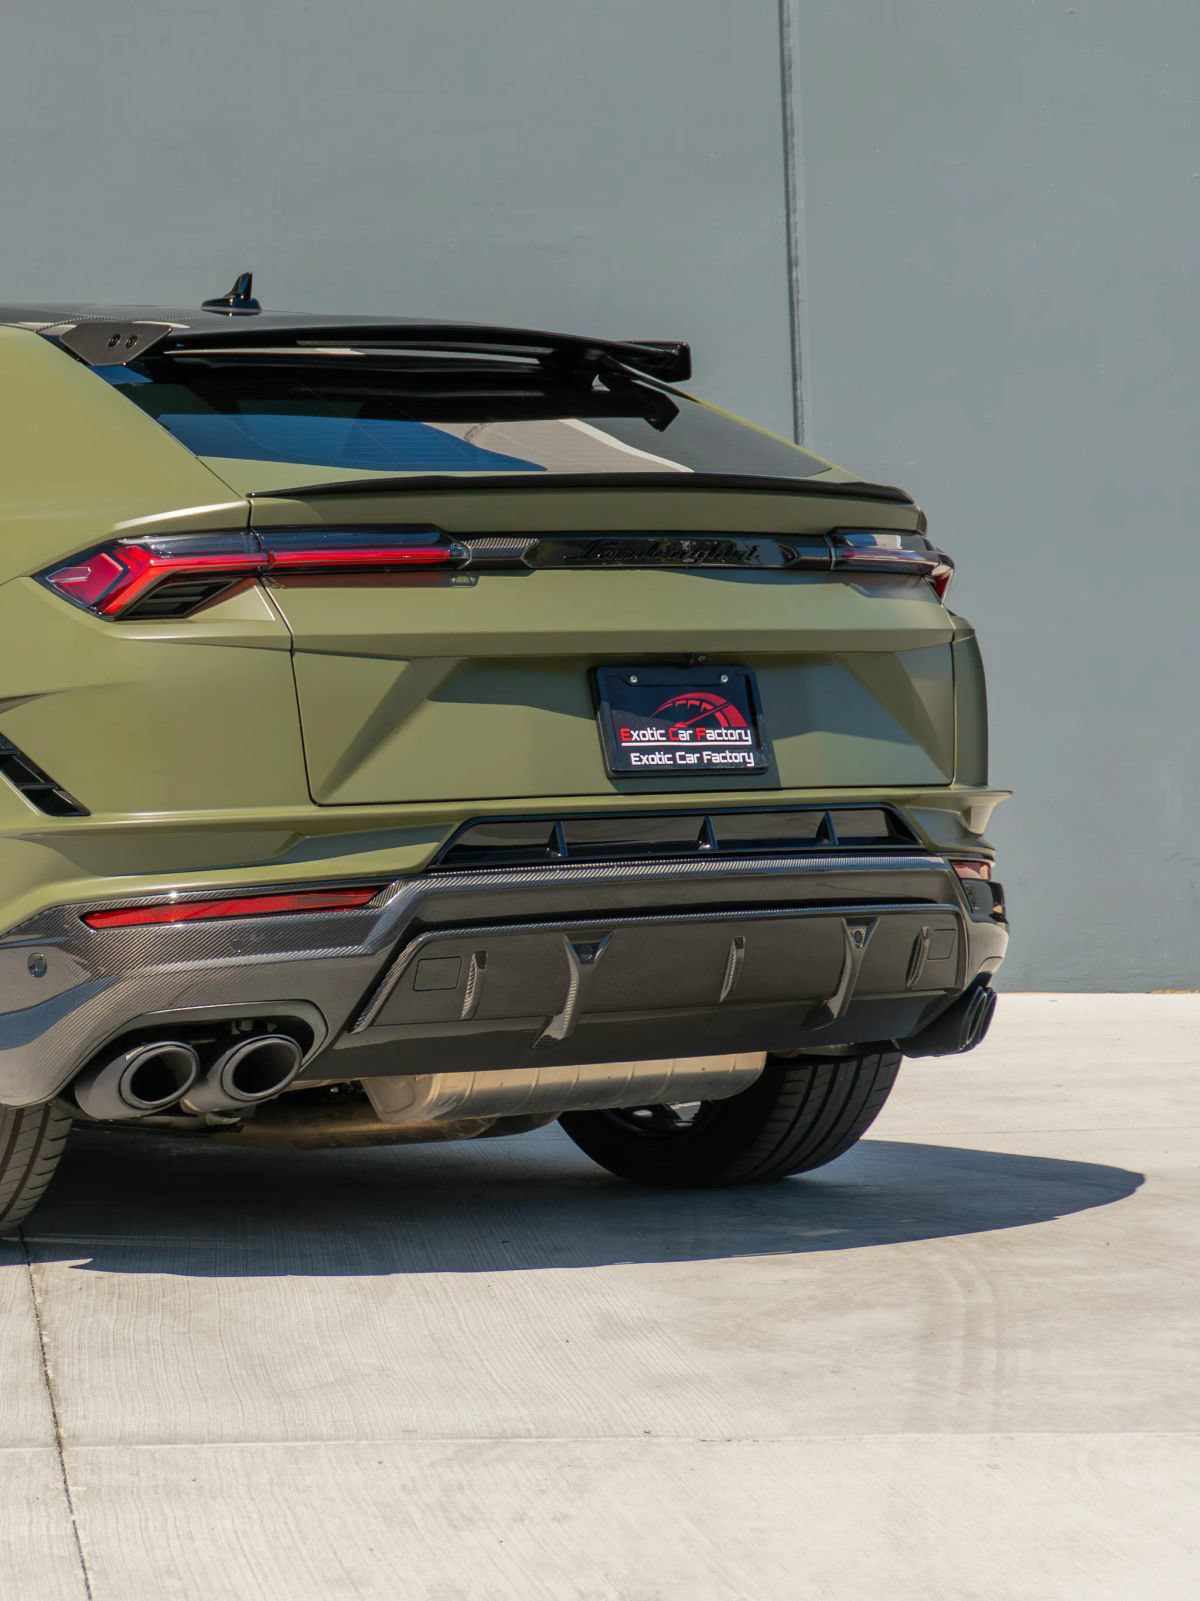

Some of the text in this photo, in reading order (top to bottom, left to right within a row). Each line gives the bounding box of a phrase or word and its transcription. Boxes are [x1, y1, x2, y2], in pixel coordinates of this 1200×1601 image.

[620, 727, 752, 745] Exotic Car Factory
[630, 750, 754, 767] Exotic Car Factory
